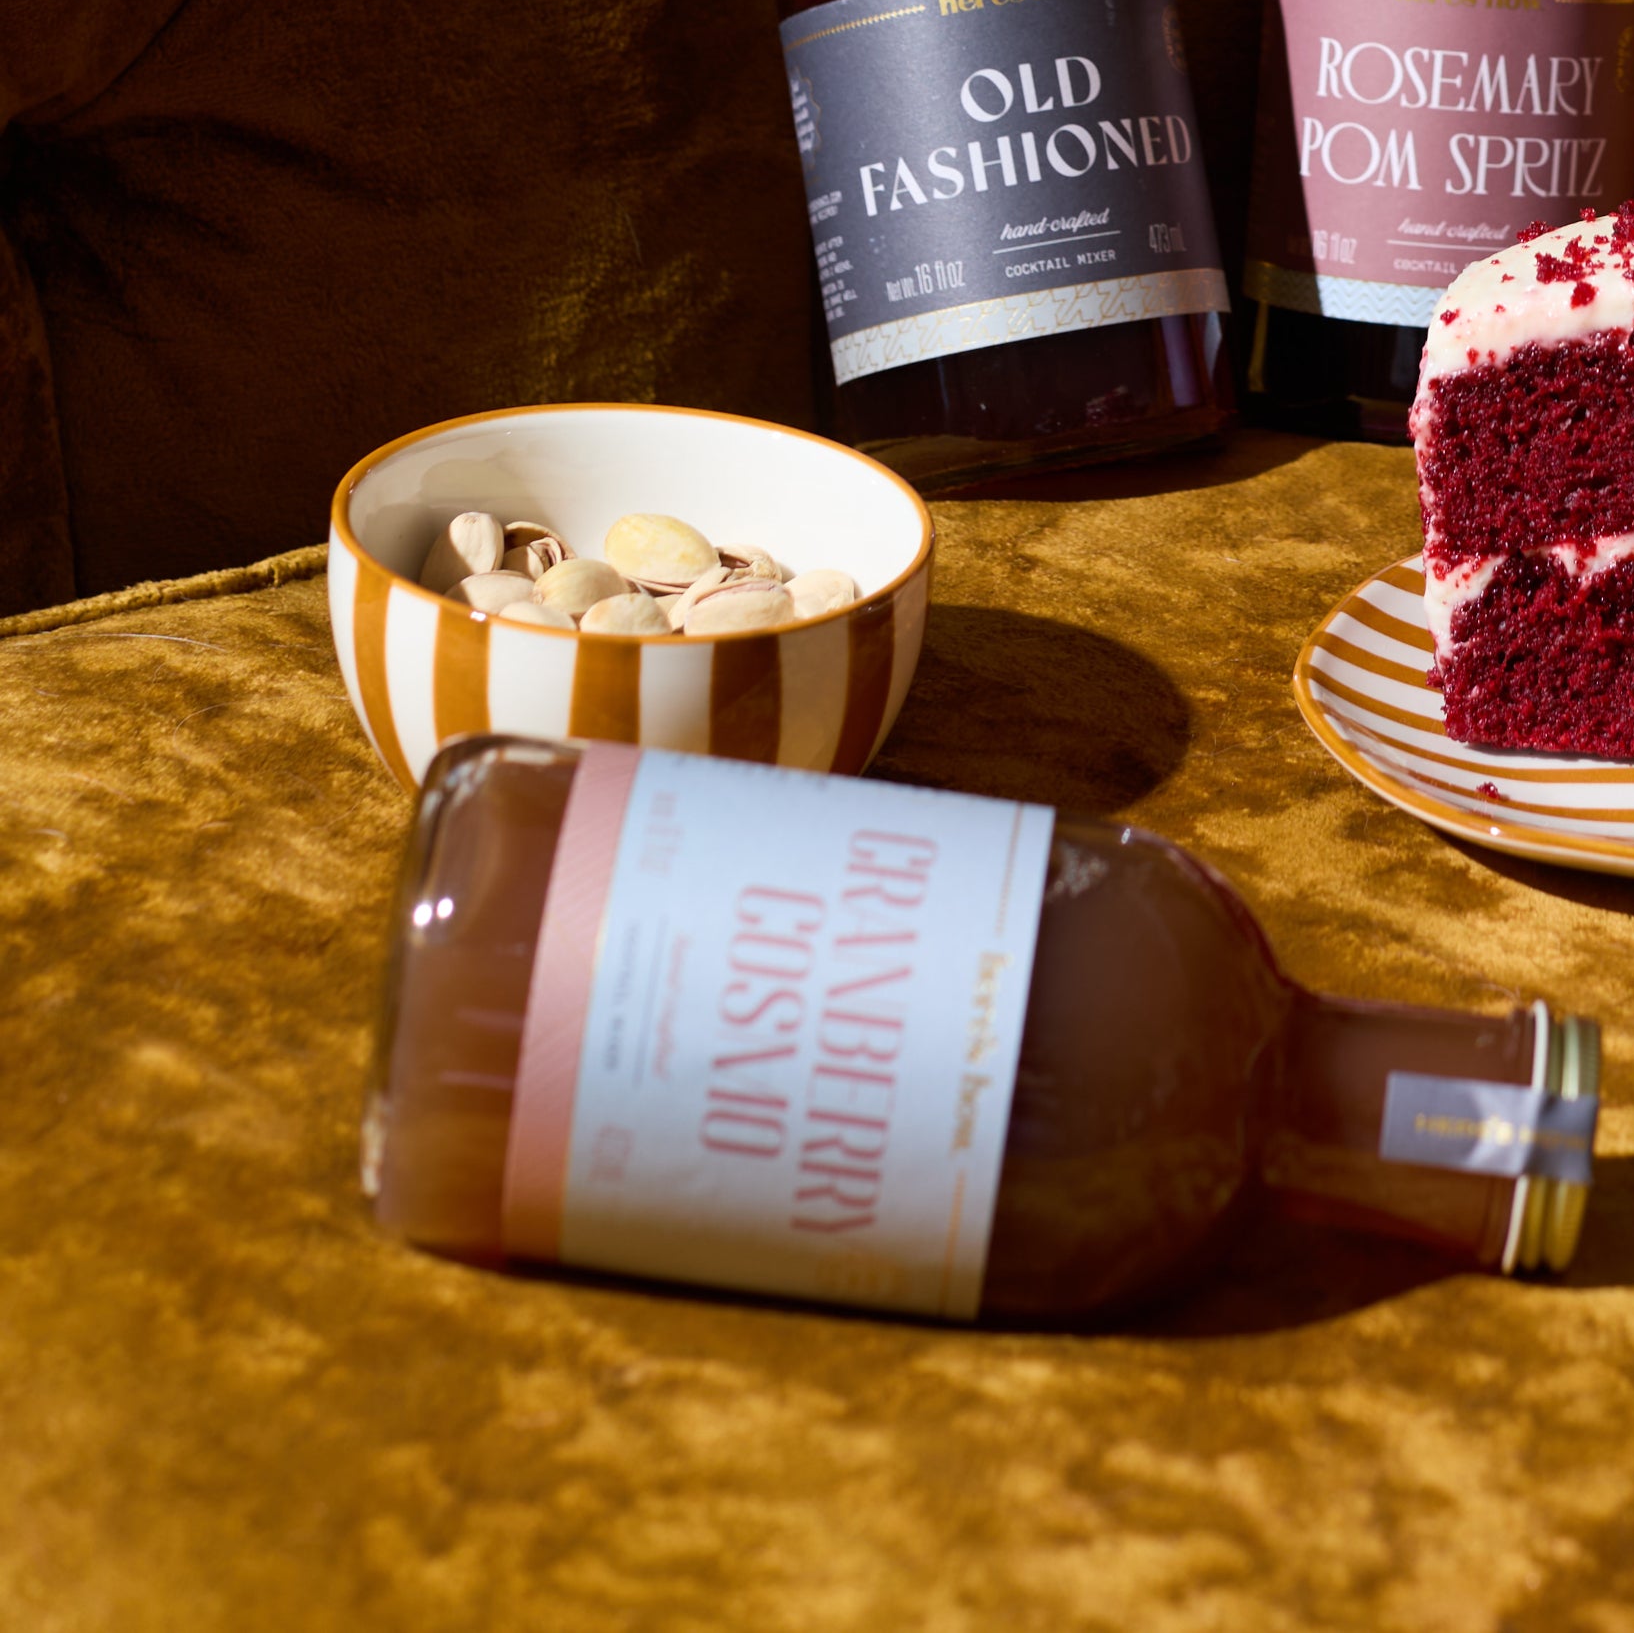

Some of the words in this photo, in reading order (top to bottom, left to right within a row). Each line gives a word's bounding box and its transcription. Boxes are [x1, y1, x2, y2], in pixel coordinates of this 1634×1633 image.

[960, 55, 1102, 123] OLD
[1316, 36, 1604, 116] ROSEMARY
[859, 115, 1192, 217] FASHIONED
[1299, 117, 1423, 191] POM
[1446, 132, 1607, 197] SPRITZ
[915, 263, 932, 294] 16
[1005, 256, 1071, 279] COCKTAIL
[1077, 249, 1117, 266] MIXER
[699, 883, 828, 1159] COSMO
[790, 828, 940, 1235] CRANBERRY
